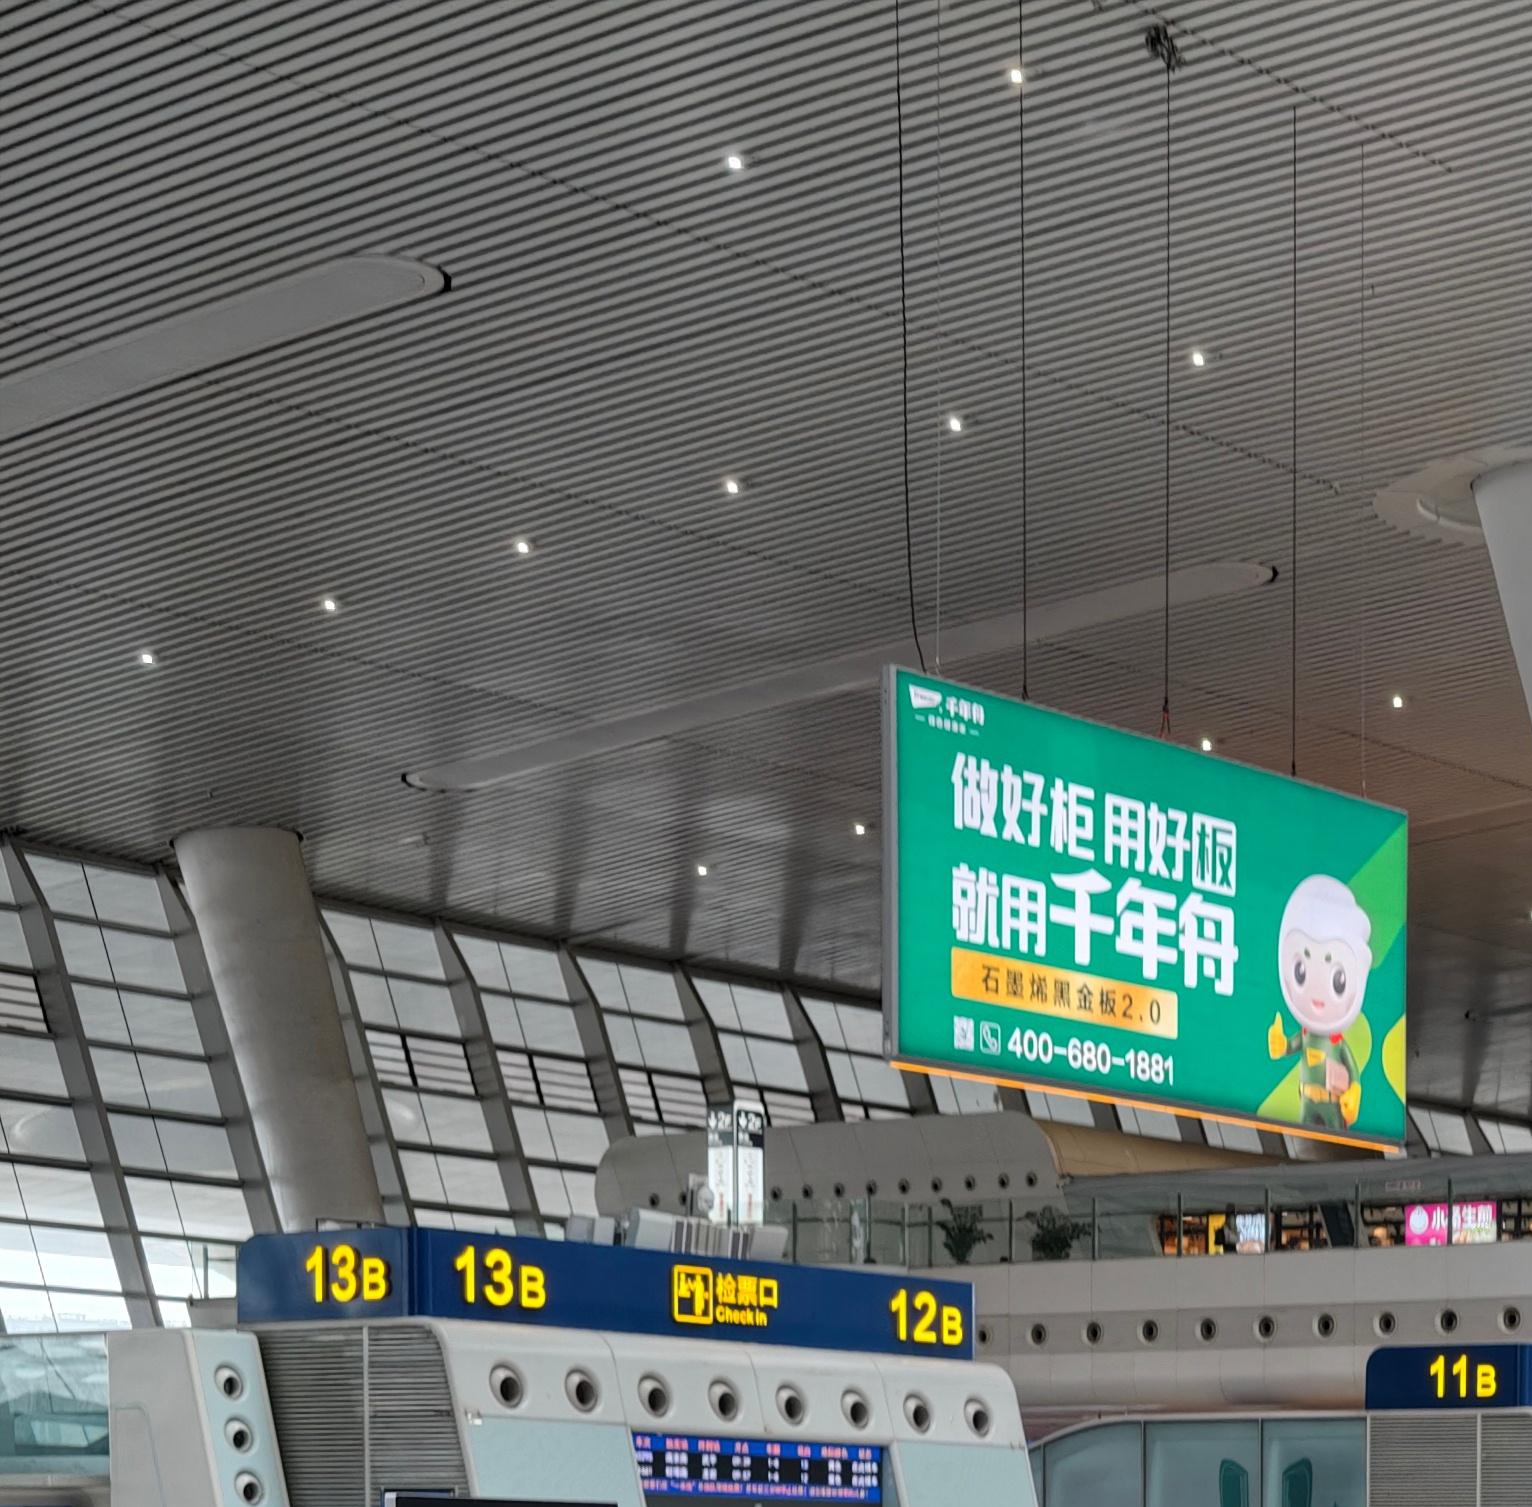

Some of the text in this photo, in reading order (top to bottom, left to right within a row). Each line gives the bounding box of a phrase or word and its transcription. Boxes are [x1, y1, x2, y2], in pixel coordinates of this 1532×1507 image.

[951, 863, 1239, 997] 就用千年舟
[981, 962, 1163, 1026] 石墨烯黑金板2.0
[1007, 1026, 1175, 1086] 400-680-1881
[305, 1244, 390, 1303] 13B
[454, 1245, 547, 1310] 13B
[715, 1273, 778, 1309] 检票口
[890, 1288, 963, 1346] 12B
[1429, 1354, 1497, 1399] 11B
